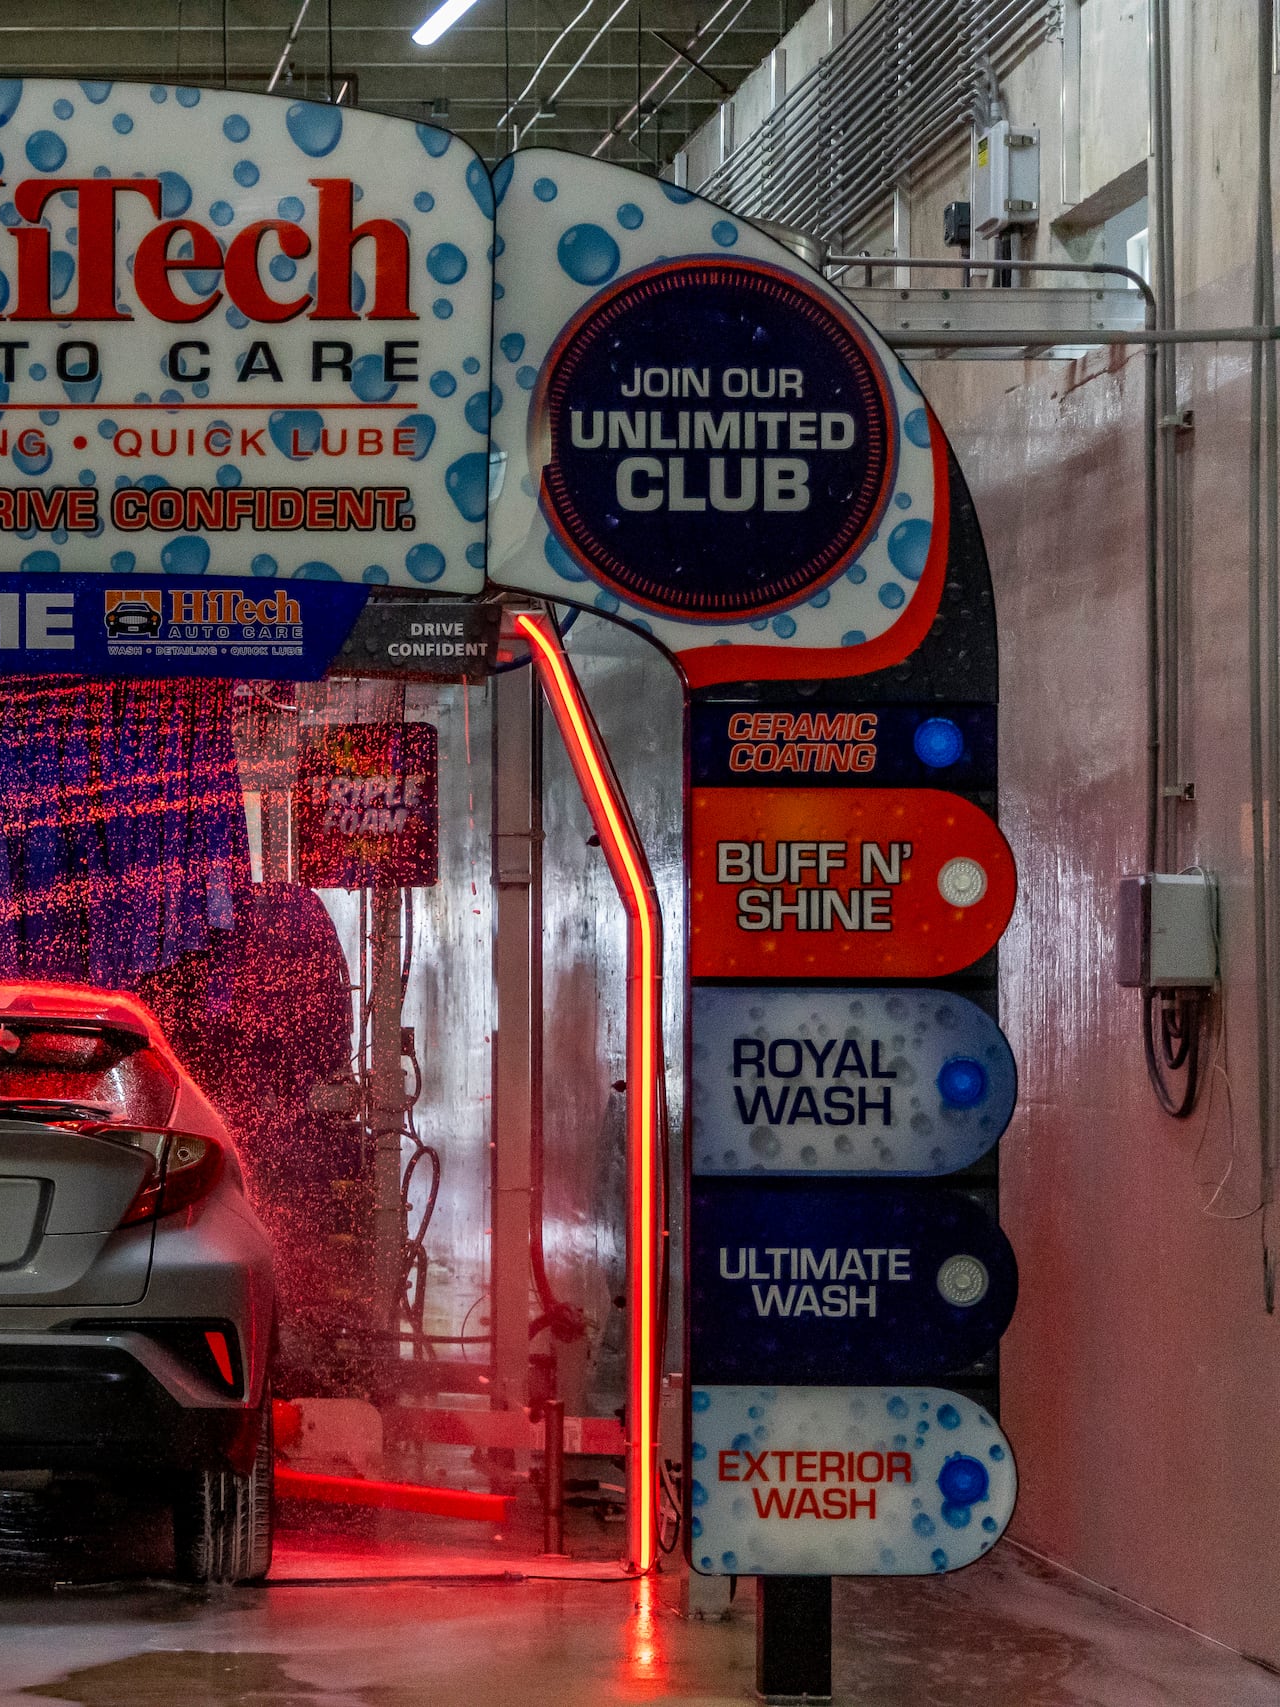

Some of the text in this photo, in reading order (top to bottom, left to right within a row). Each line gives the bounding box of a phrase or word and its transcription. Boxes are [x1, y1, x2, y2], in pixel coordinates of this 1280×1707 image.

[168, 340, 419, 383] CARE
[621, 367, 804, 398] JOIN OUR
[113, 428, 267, 458] QUICK
[291, 428, 417, 457] LUBE
[570, 411, 855, 449] UNLIMITED
[616, 457, 809, 511] CLUB
[111, 487, 417, 532] CONFIDENT.
[168, 590, 303, 625] HiTech
[168, 626, 304, 638] AUTO CARE
[410, 623, 464, 637] DRIVE
[108, 646, 304, 656] WASH DETAILING QUICK LUBE
[388, 642, 488, 657] CONFIDENT
[728, 713, 878, 741] CERAMIC
[729, 743, 877, 772] COATING
[717, 841, 847, 885] BUFF
[737, 889, 893, 931] SHINE
[733, 1038, 897, 1079] ROYAL
[733, 1085, 892, 1126] WASH
[719, 1247, 911, 1281] ULTIMATE
[752, 1285, 877, 1318] WASH
[718, 1450, 912, 1483] EXTERIOR
[752, 1488, 877, 1520] WASH
